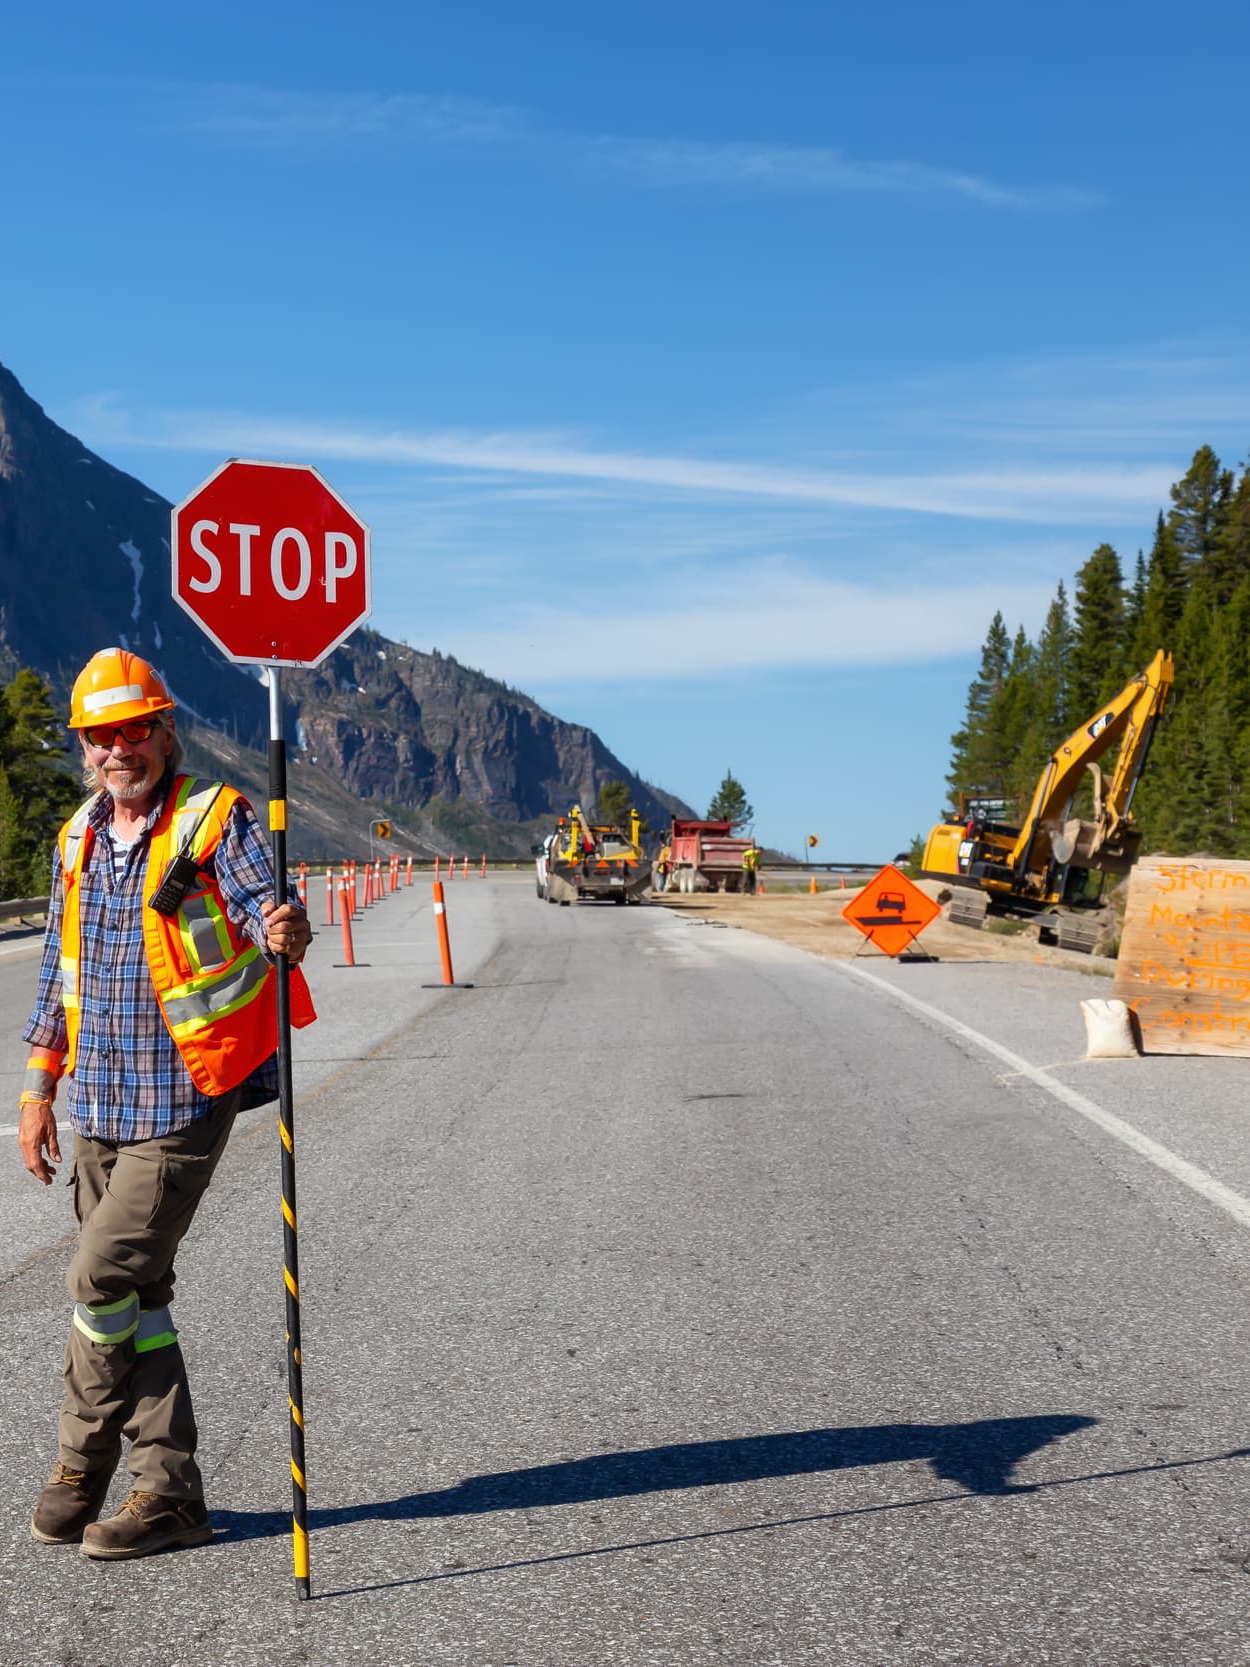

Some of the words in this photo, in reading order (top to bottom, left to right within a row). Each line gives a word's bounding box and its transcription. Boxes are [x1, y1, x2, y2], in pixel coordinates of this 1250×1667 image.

[189, 519, 358, 604] STOP
[1156, 864, 1248, 892] Storm
[1143, 960, 1250, 1001] During
[1130, 996, 1250, 1032] Constr
